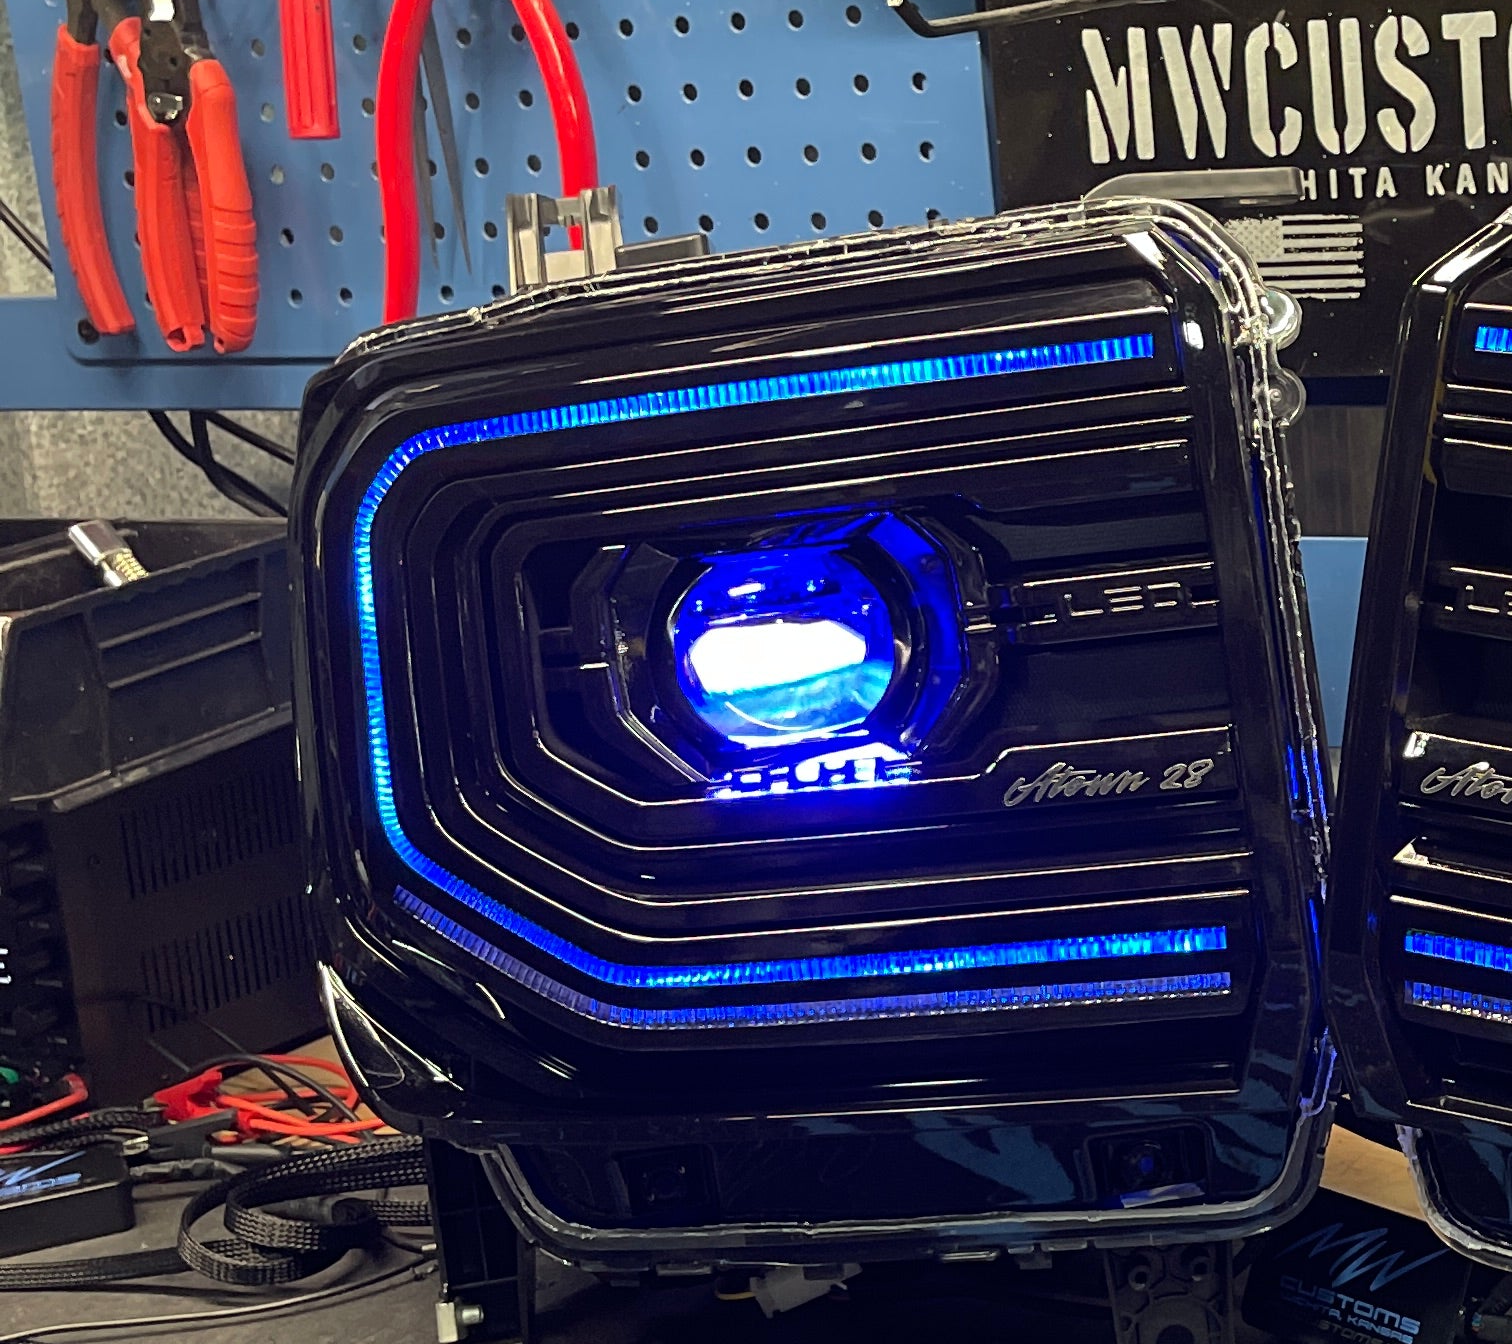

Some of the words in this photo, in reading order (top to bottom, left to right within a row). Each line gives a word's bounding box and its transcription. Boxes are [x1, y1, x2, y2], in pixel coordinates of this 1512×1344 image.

[1300, 166, 1399, 201] HITA
[1159, 758, 1215, 790] 28
[1280, 1274, 1421, 1335] CUSTOMS
